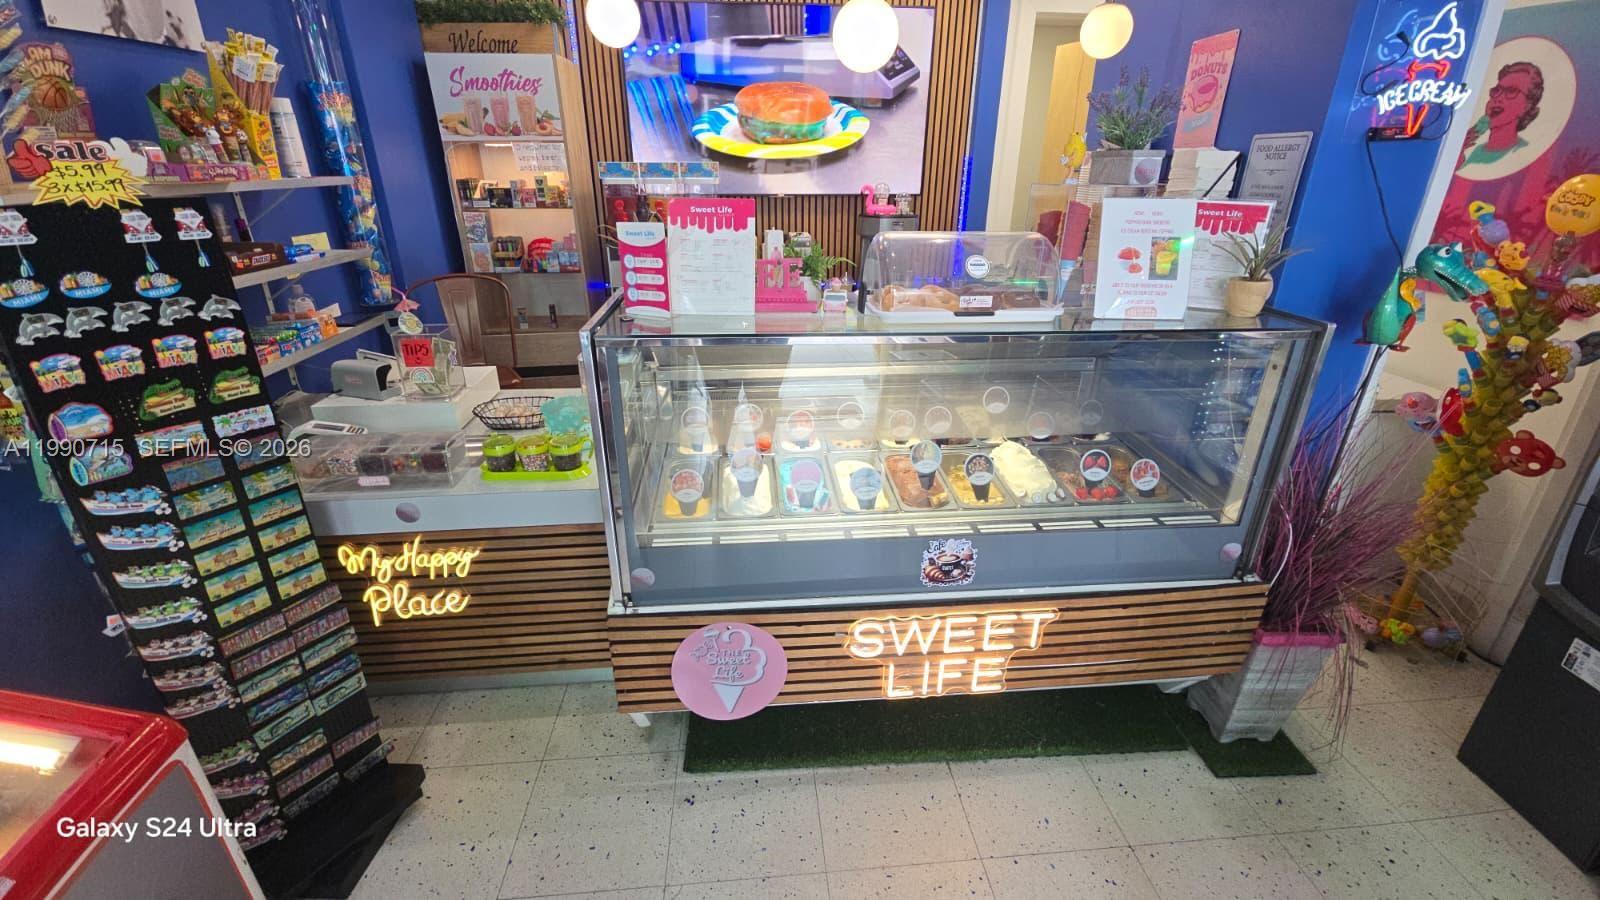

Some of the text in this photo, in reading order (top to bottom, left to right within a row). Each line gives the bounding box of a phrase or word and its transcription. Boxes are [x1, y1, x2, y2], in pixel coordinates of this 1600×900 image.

[448, 30, 518, 54] Welcome
[29, 60, 71, 82] DUNK
[1190, 62, 1228, 80] DONUTS
[450, 66, 543, 98] Smoothies
[1376, 79, 1472, 115] ICE CREAM
[35, 140, 107, 161] sale
[1256, 143, 1301, 153] FOOD ALLERGY
[1264, 151, 1288, 161] NOTICE
[54, 163, 107, 180] $5.99
[690, 205, 733, 214] Sweet Life
[1198, 208, 1243, 218] Sweet Life
[625, 230, 643, 238] Sweet
[13, 294, 40, 307] MIAMI
[75, 287, 103, 298] MIAMI
[150, 287, 175, 297] MIAMI
[403, 342, 429, 358] TIPS
[338, 534, 482, 583] My Happy
[362, 581, 471, 627] Place
[849, 613, 1056, 658] SWEET
[887, 657, 1005, 698] LIFE
